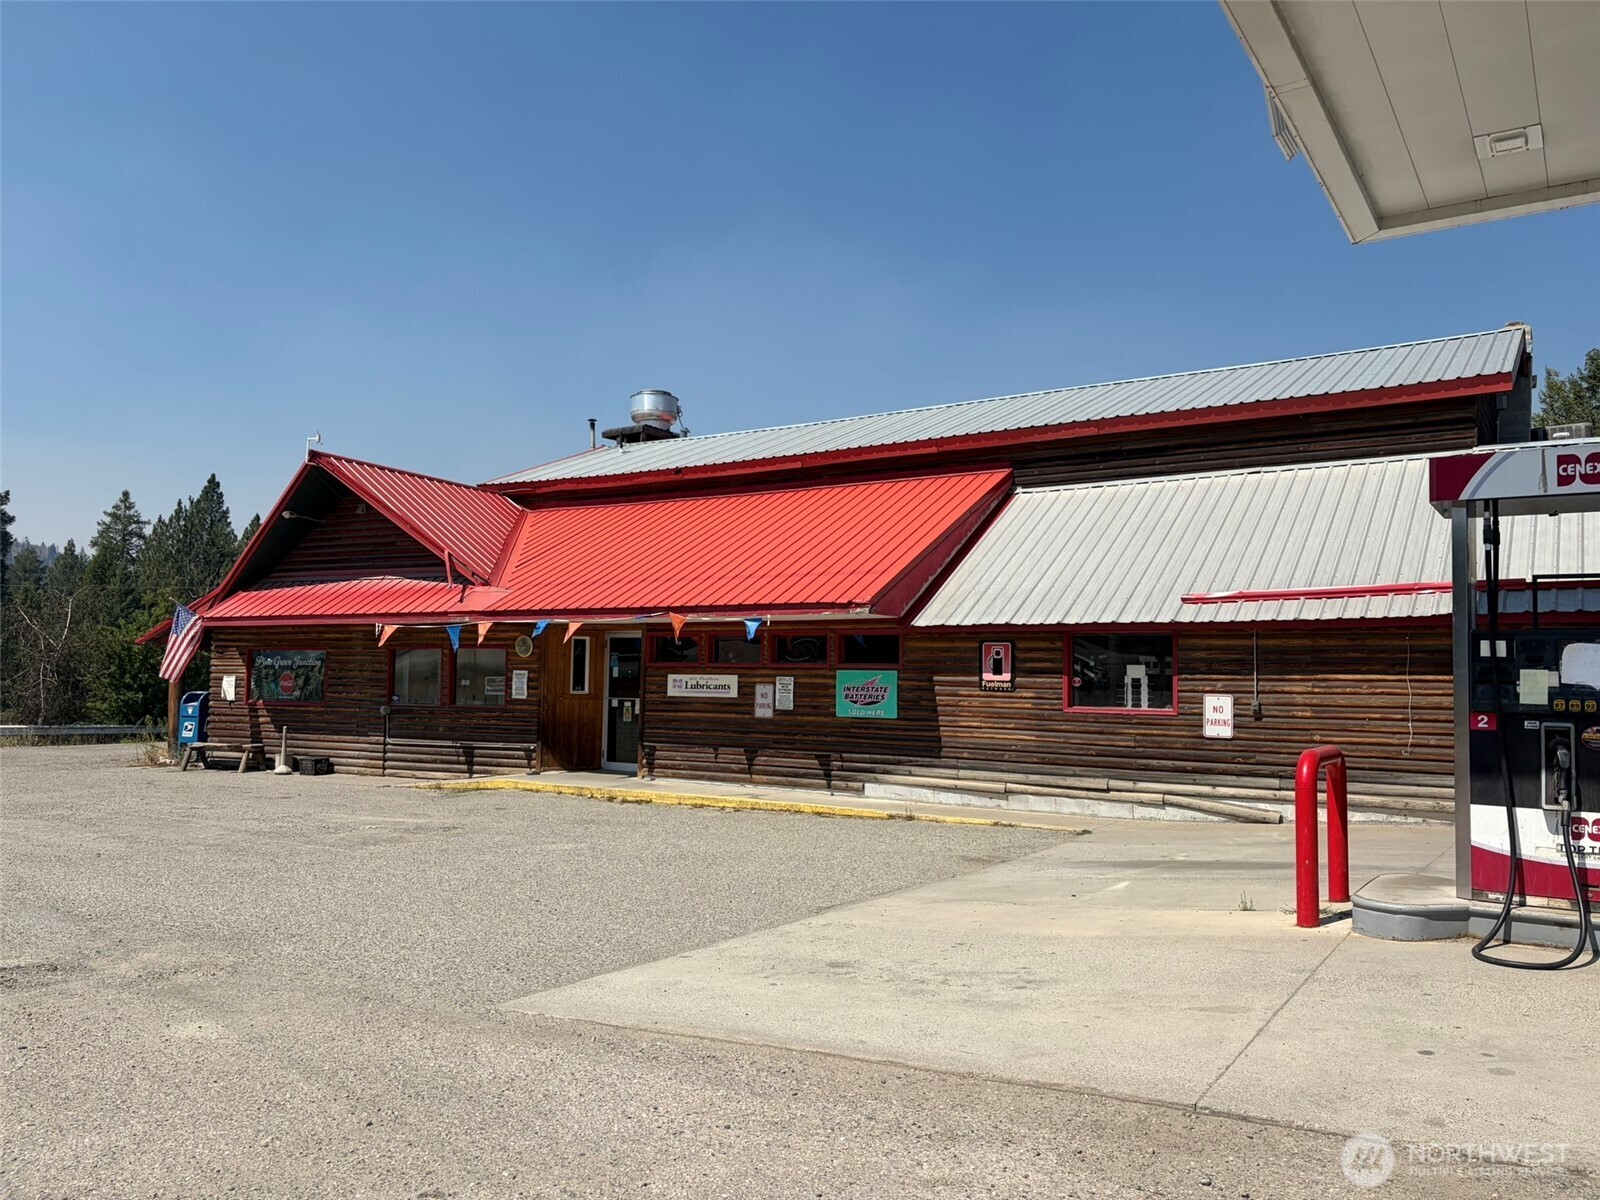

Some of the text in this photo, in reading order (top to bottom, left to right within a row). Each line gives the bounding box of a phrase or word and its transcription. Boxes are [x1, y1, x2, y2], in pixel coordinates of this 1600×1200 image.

[273, 655, 293, 669] Grove
[293, 655, 322, 669] Junction
[685, 680, 731, 690] Lubricants
[982, 680, 1011, 688] Fuelman
[1212, 705, 1224, 714] NO
[1570, 702, 1580, 710] 89
[1206, 718, 1231, 727] PARKING
[1477, 715, 1489, 728] 2
[1572, 824, 1600, 834] CENE
